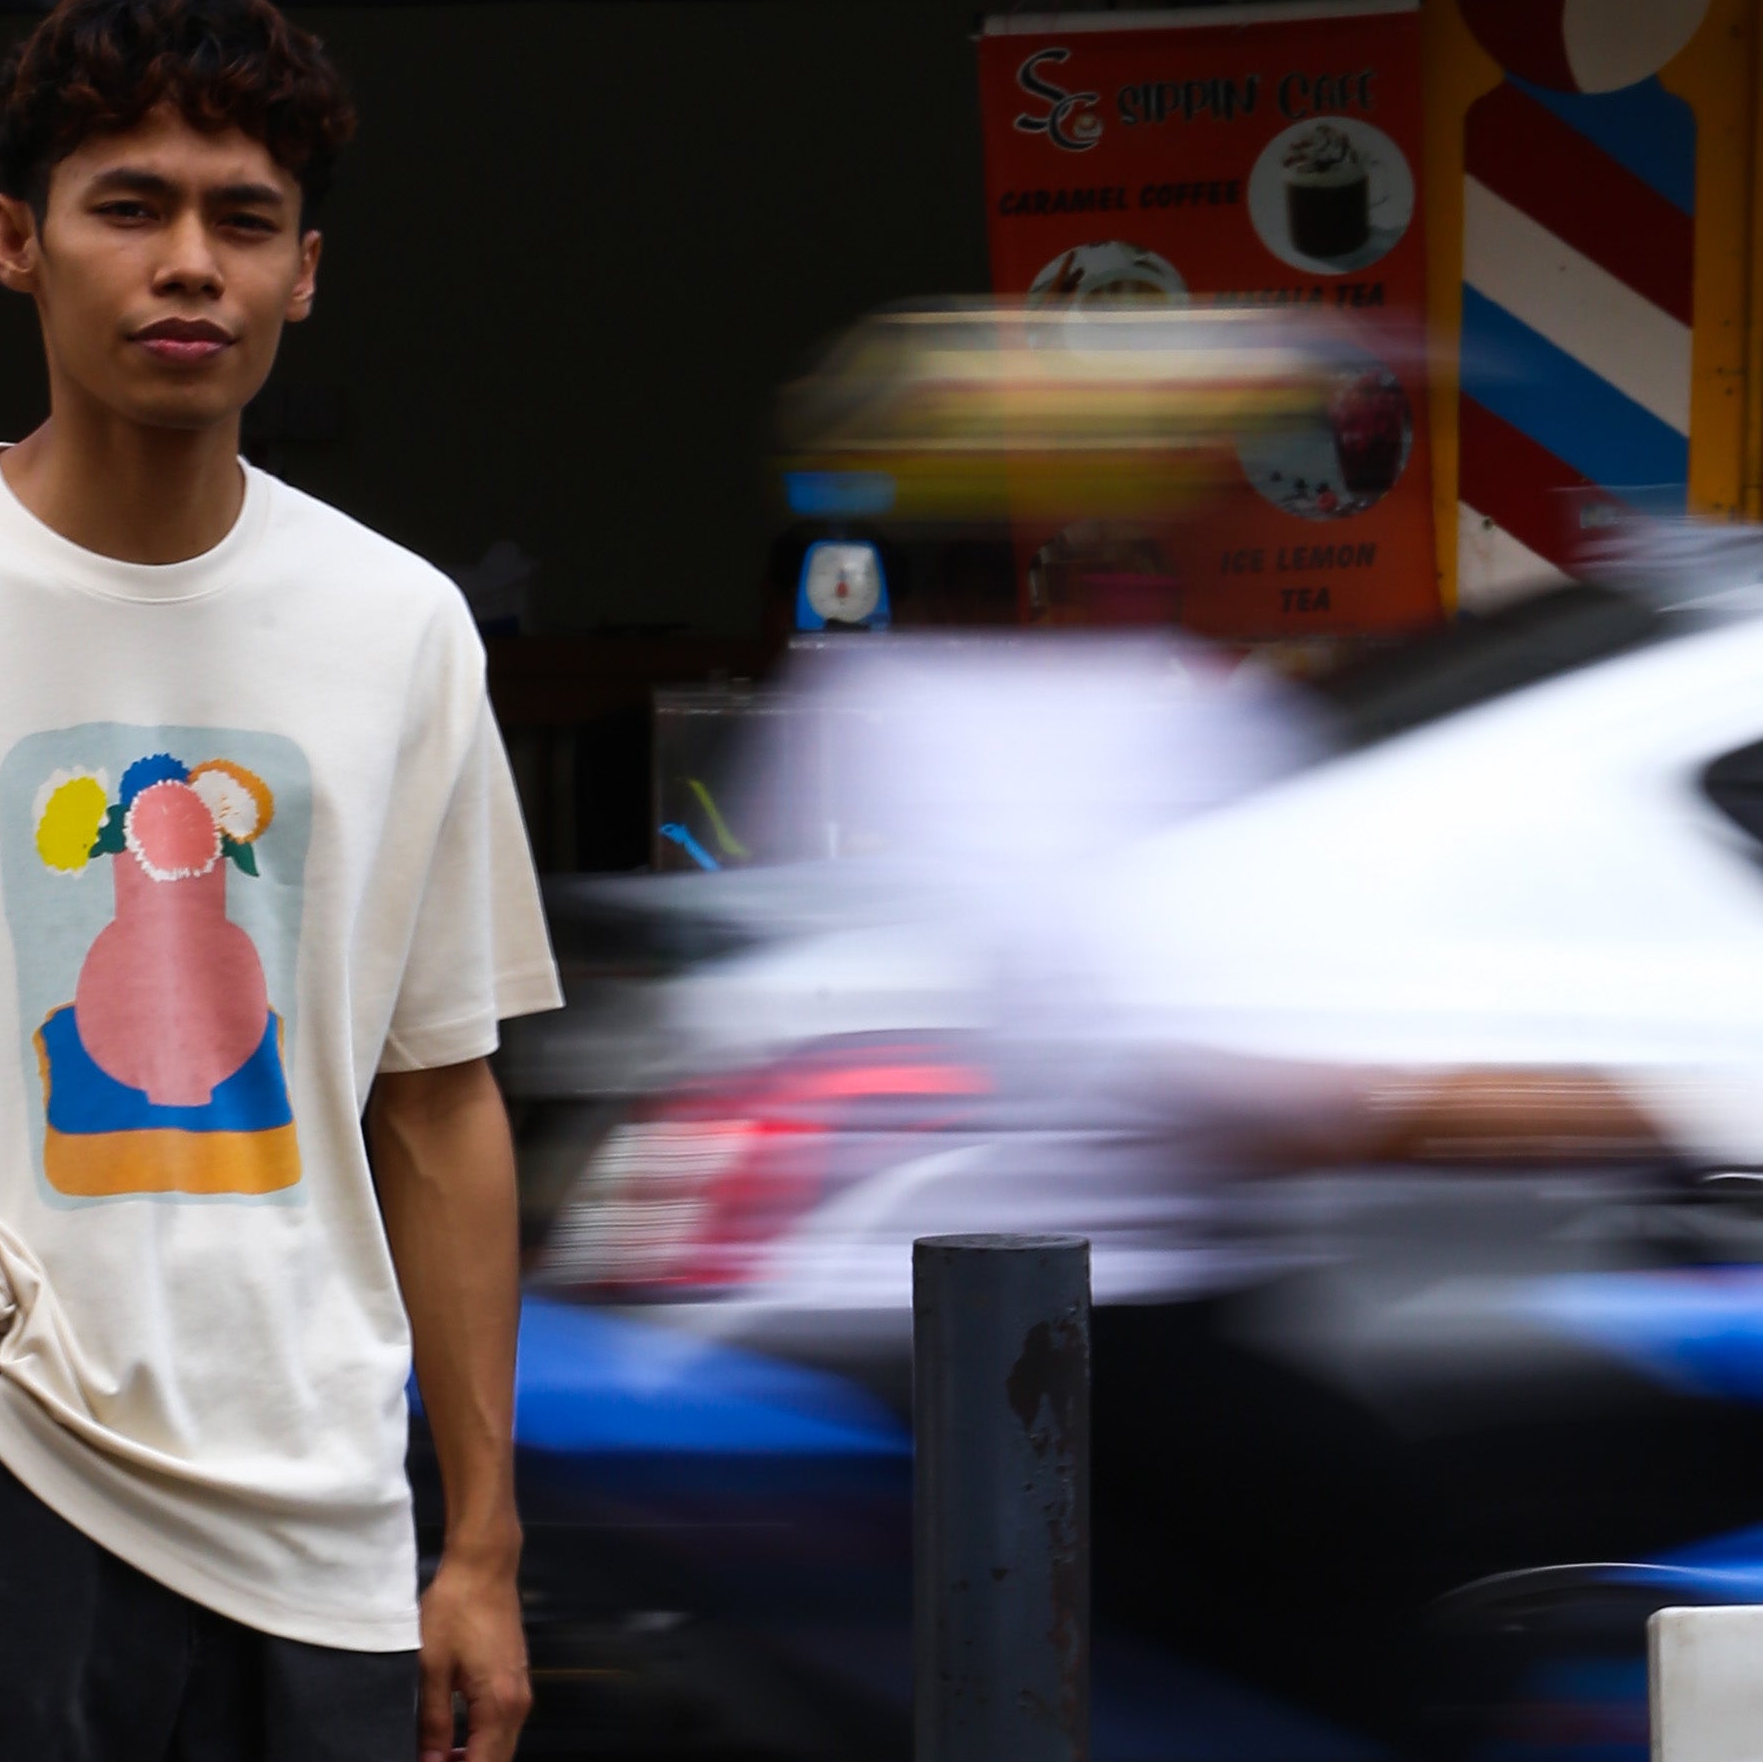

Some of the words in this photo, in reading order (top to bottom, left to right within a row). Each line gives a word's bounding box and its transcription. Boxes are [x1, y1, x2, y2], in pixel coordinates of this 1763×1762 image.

[999, 187, 1128, 216] CARAMEL
[1140, 180, 1242, 210] COFFEE
[1336, 282, 1384, 308] TEA
[1222, 549, 1264, 574] ICE
[1277, 543, 1376, 572] LEMON
[1281, 588, 1331, 613] TEA
